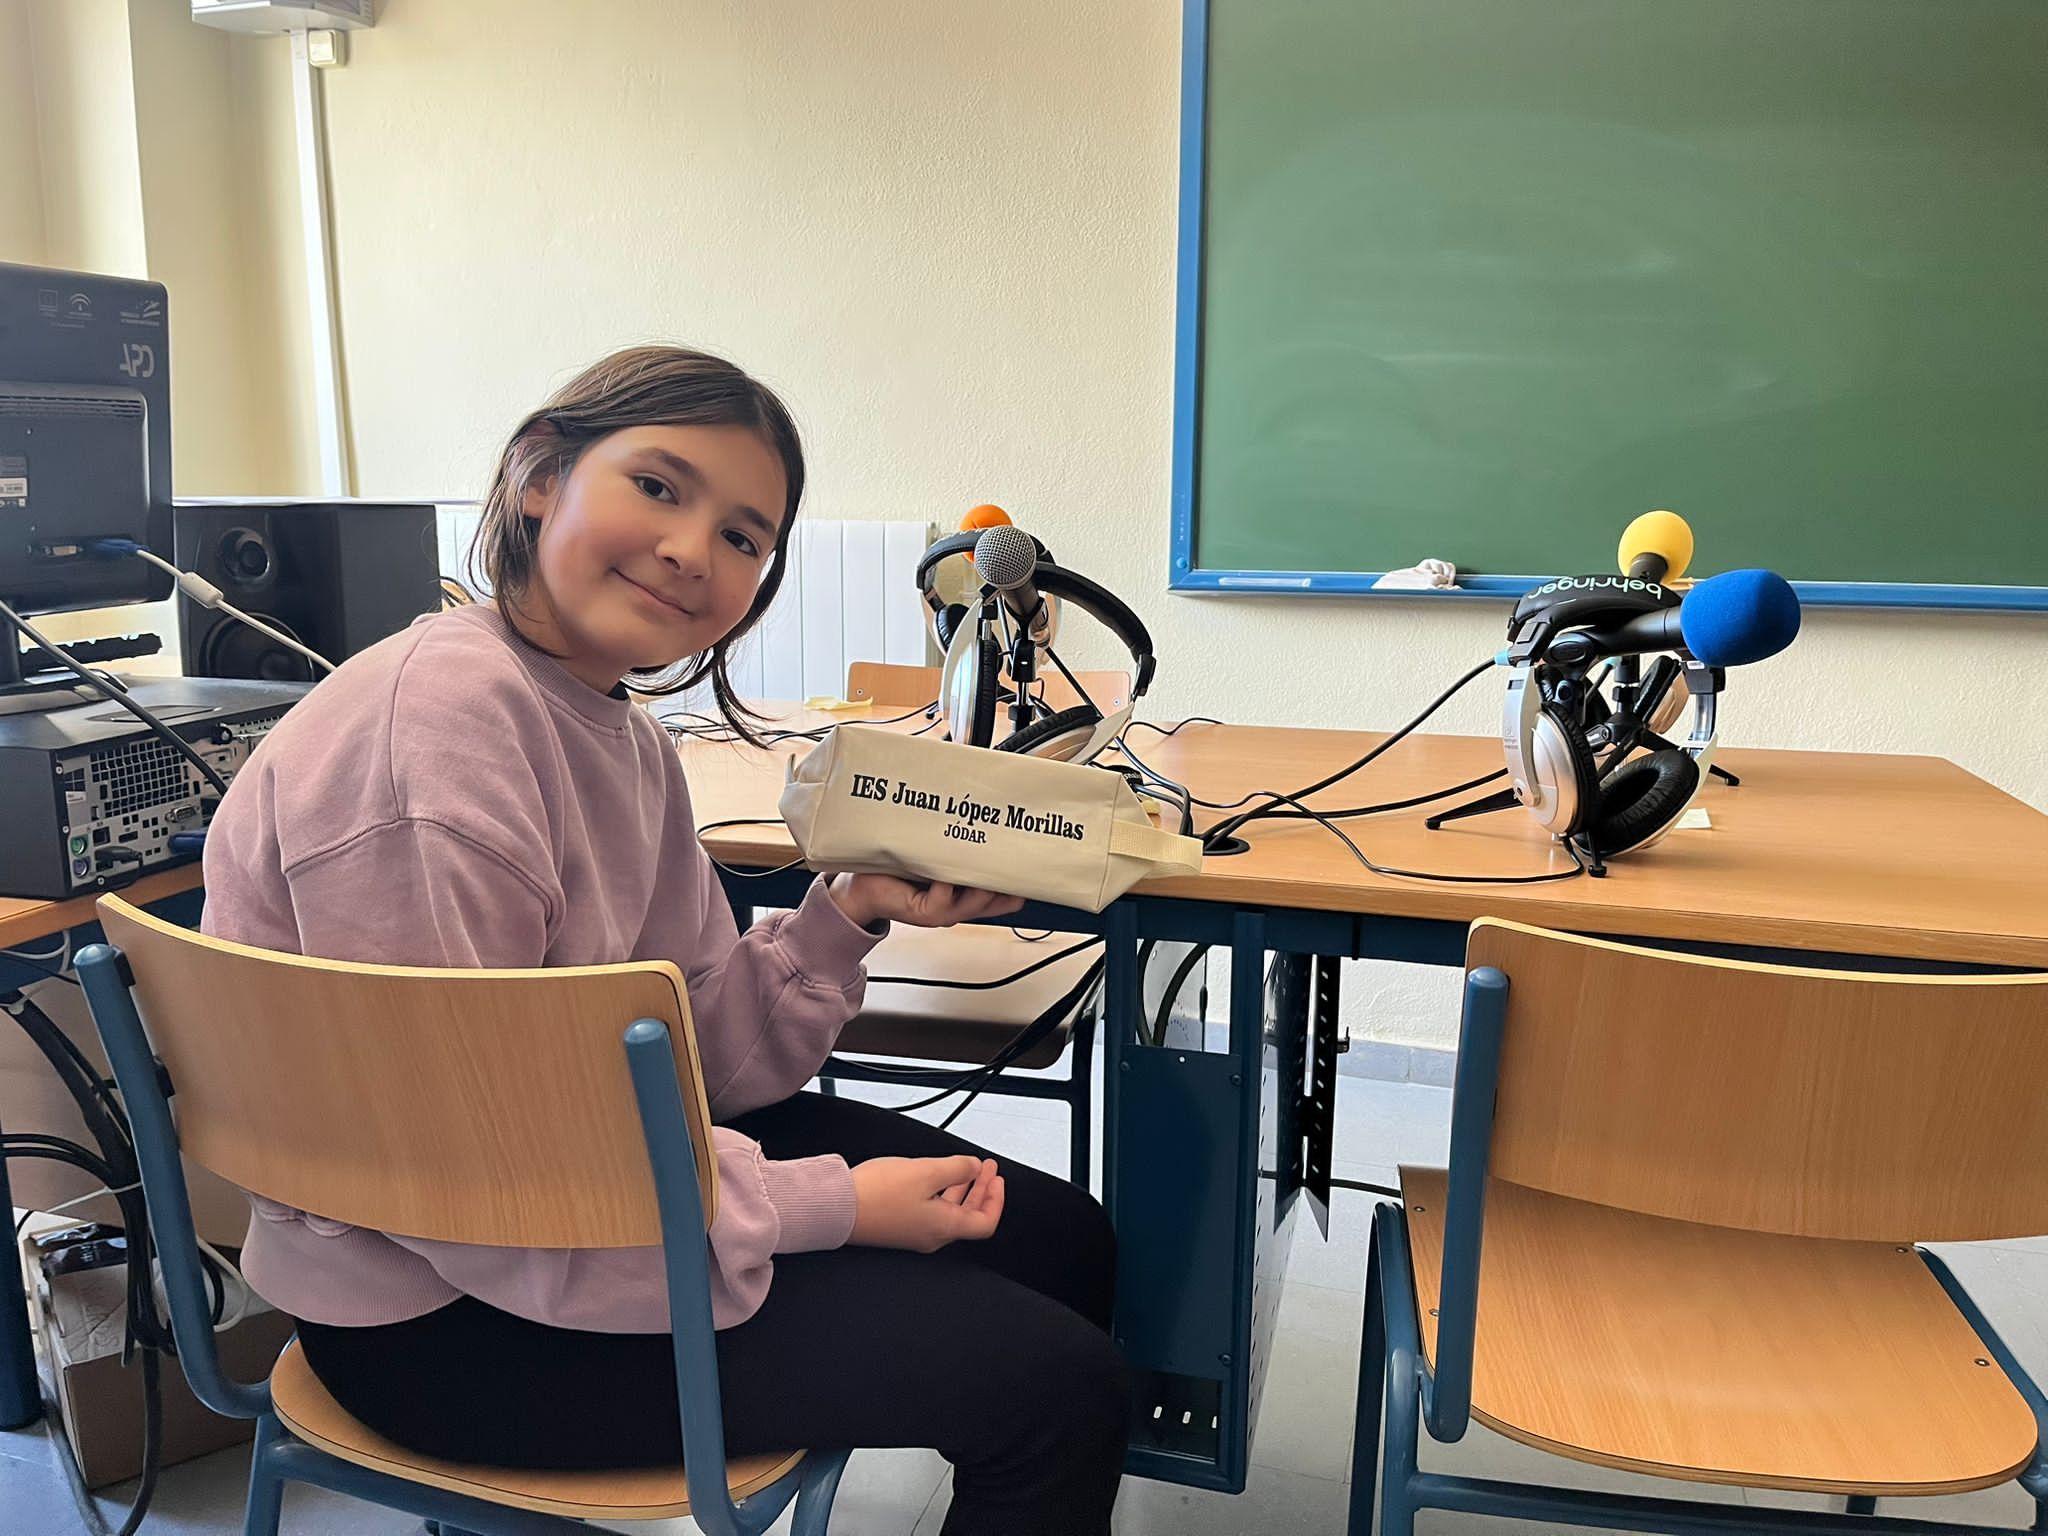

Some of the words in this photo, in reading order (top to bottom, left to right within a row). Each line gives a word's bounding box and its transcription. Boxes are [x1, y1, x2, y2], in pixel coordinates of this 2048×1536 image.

[1527, 576, 1662, 600] behringer
[850, 774, 889, 801] IES
[892, 781, 941, 811] Juan
[945, 793, 1001, 826] López
[1004, 804, 1085, 841] Morillas
[943, 821, 987, 844] JÓDAR
